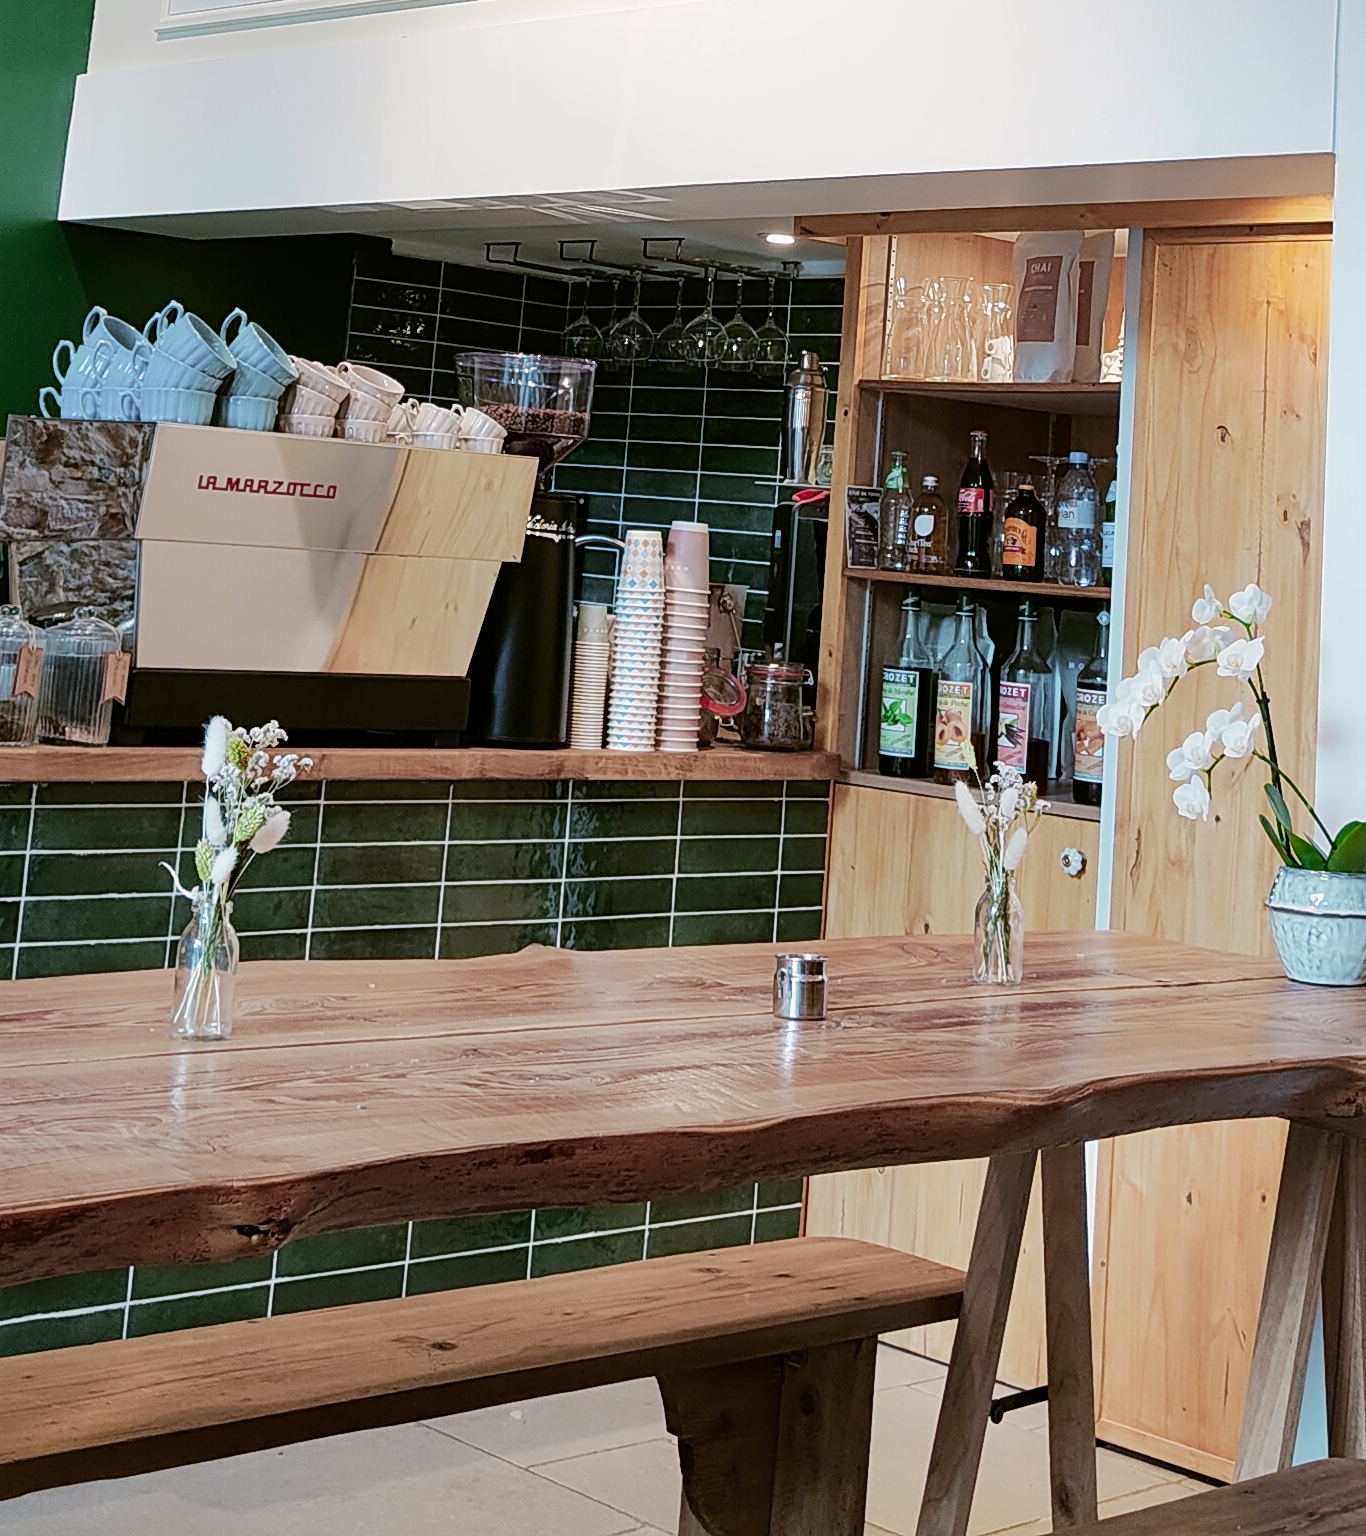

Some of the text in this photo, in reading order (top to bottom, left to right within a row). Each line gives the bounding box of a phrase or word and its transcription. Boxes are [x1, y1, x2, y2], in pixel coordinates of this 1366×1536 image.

[1031, 263, 1051, 273] CHAI
[197, 474, 337, 499] LA MARZOCCO
[883, 672, 915, 684] ROZET
